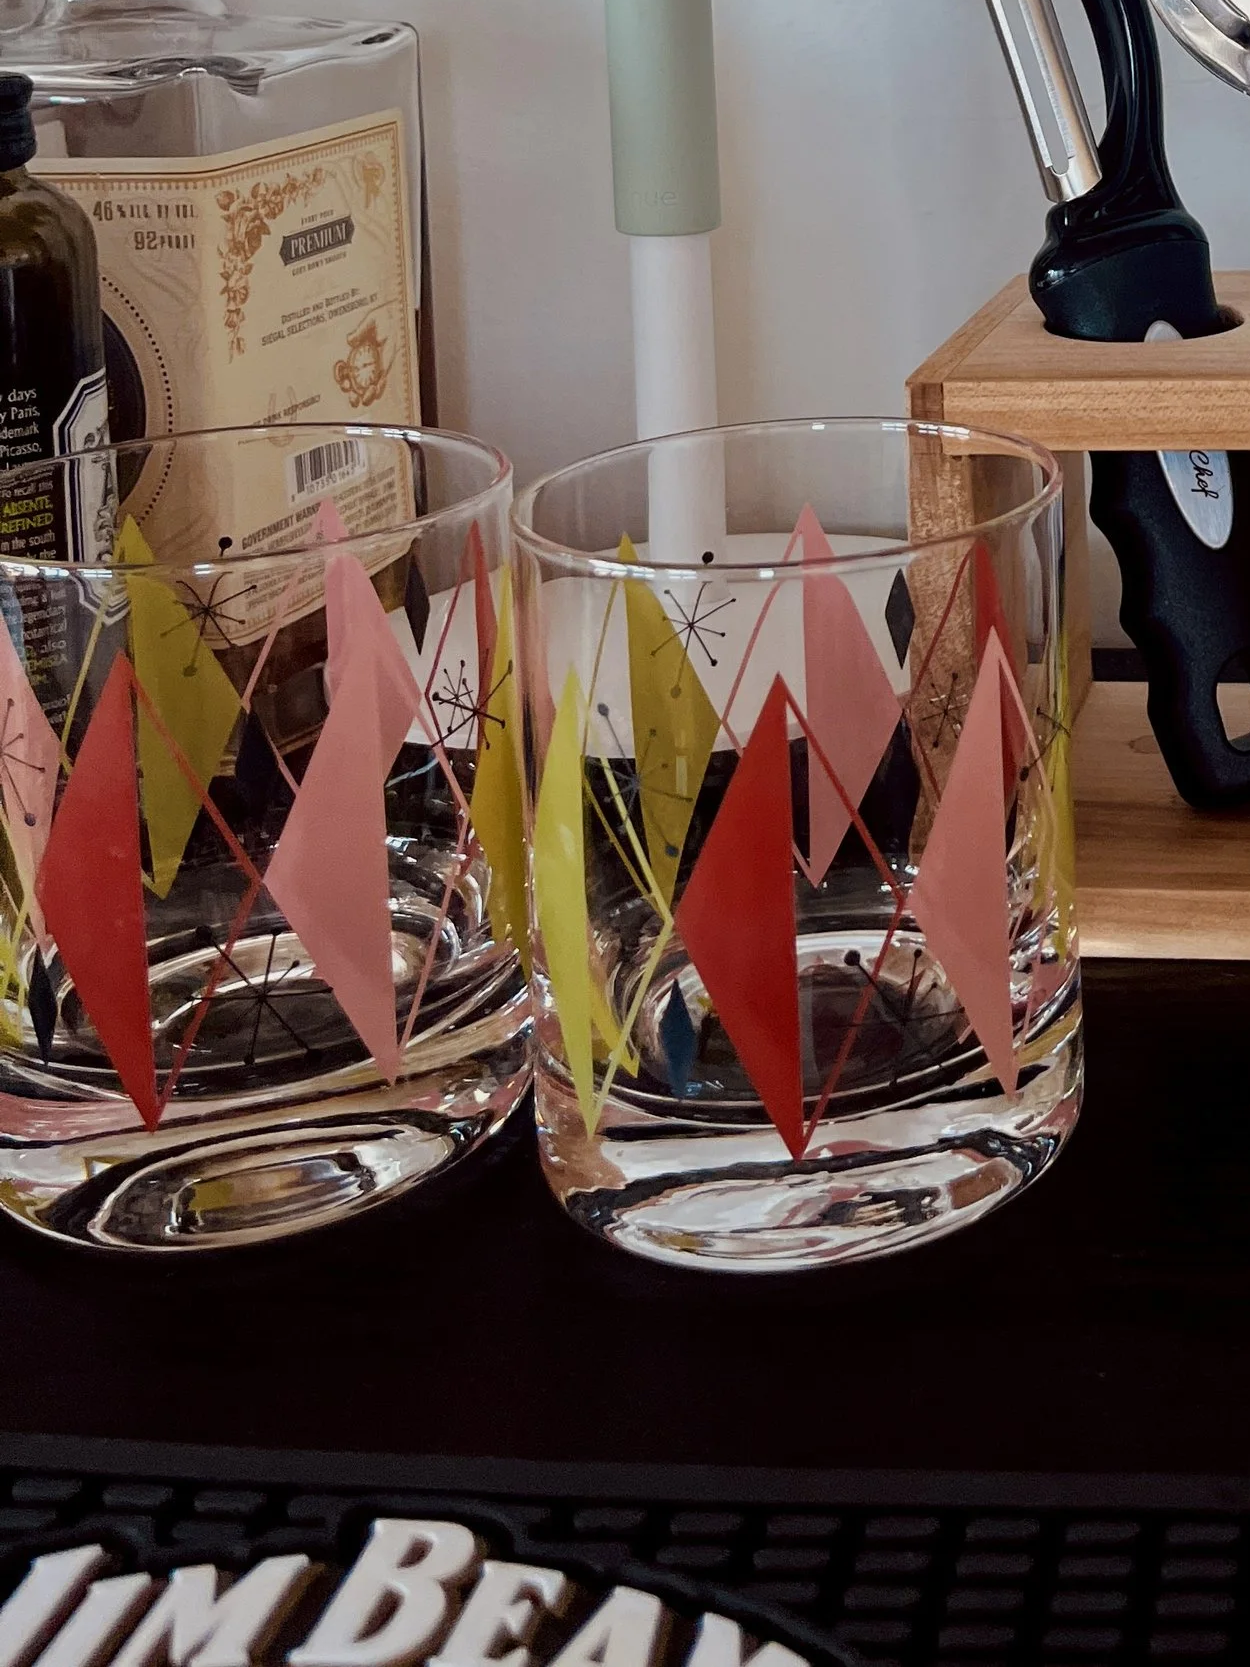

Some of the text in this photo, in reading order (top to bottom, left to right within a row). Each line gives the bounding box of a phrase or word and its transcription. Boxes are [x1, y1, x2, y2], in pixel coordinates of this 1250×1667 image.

[290, 222, 347, 259] PREMIUM
[8, 388, 37, 402] days
[11, 406, 40, 420] Paris,
[0, 442, 42, 458] Picasso,
[1189, 450, 1219, 499] Chef
[29, 529, 56, 546] south
